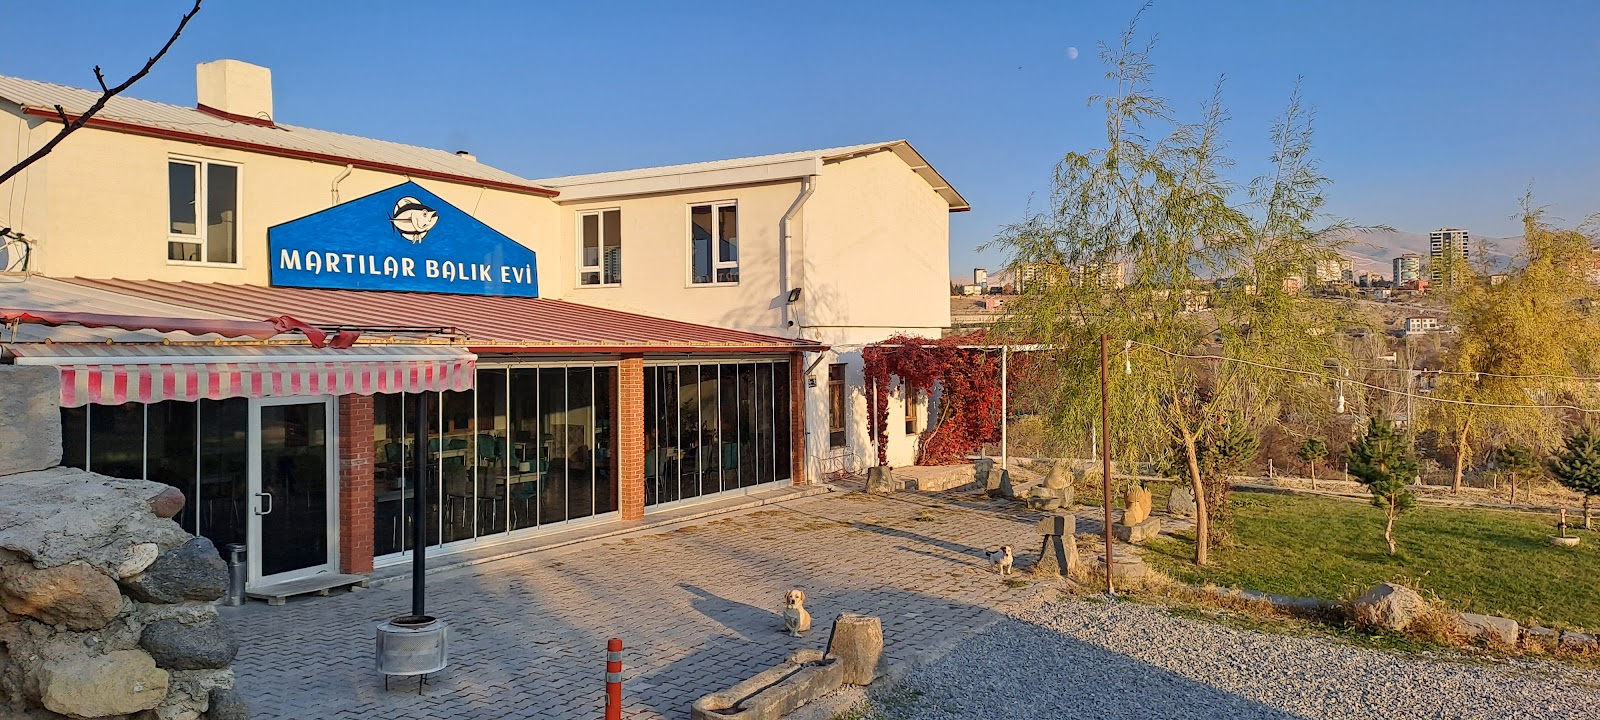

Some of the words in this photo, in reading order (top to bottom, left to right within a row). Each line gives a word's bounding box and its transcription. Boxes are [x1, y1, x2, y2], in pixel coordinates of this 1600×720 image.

[280, 248, 416, 279] MARTILAR
[425, 259, 493, 282] BALIK
[501, 263, 532, 284] EVİ
